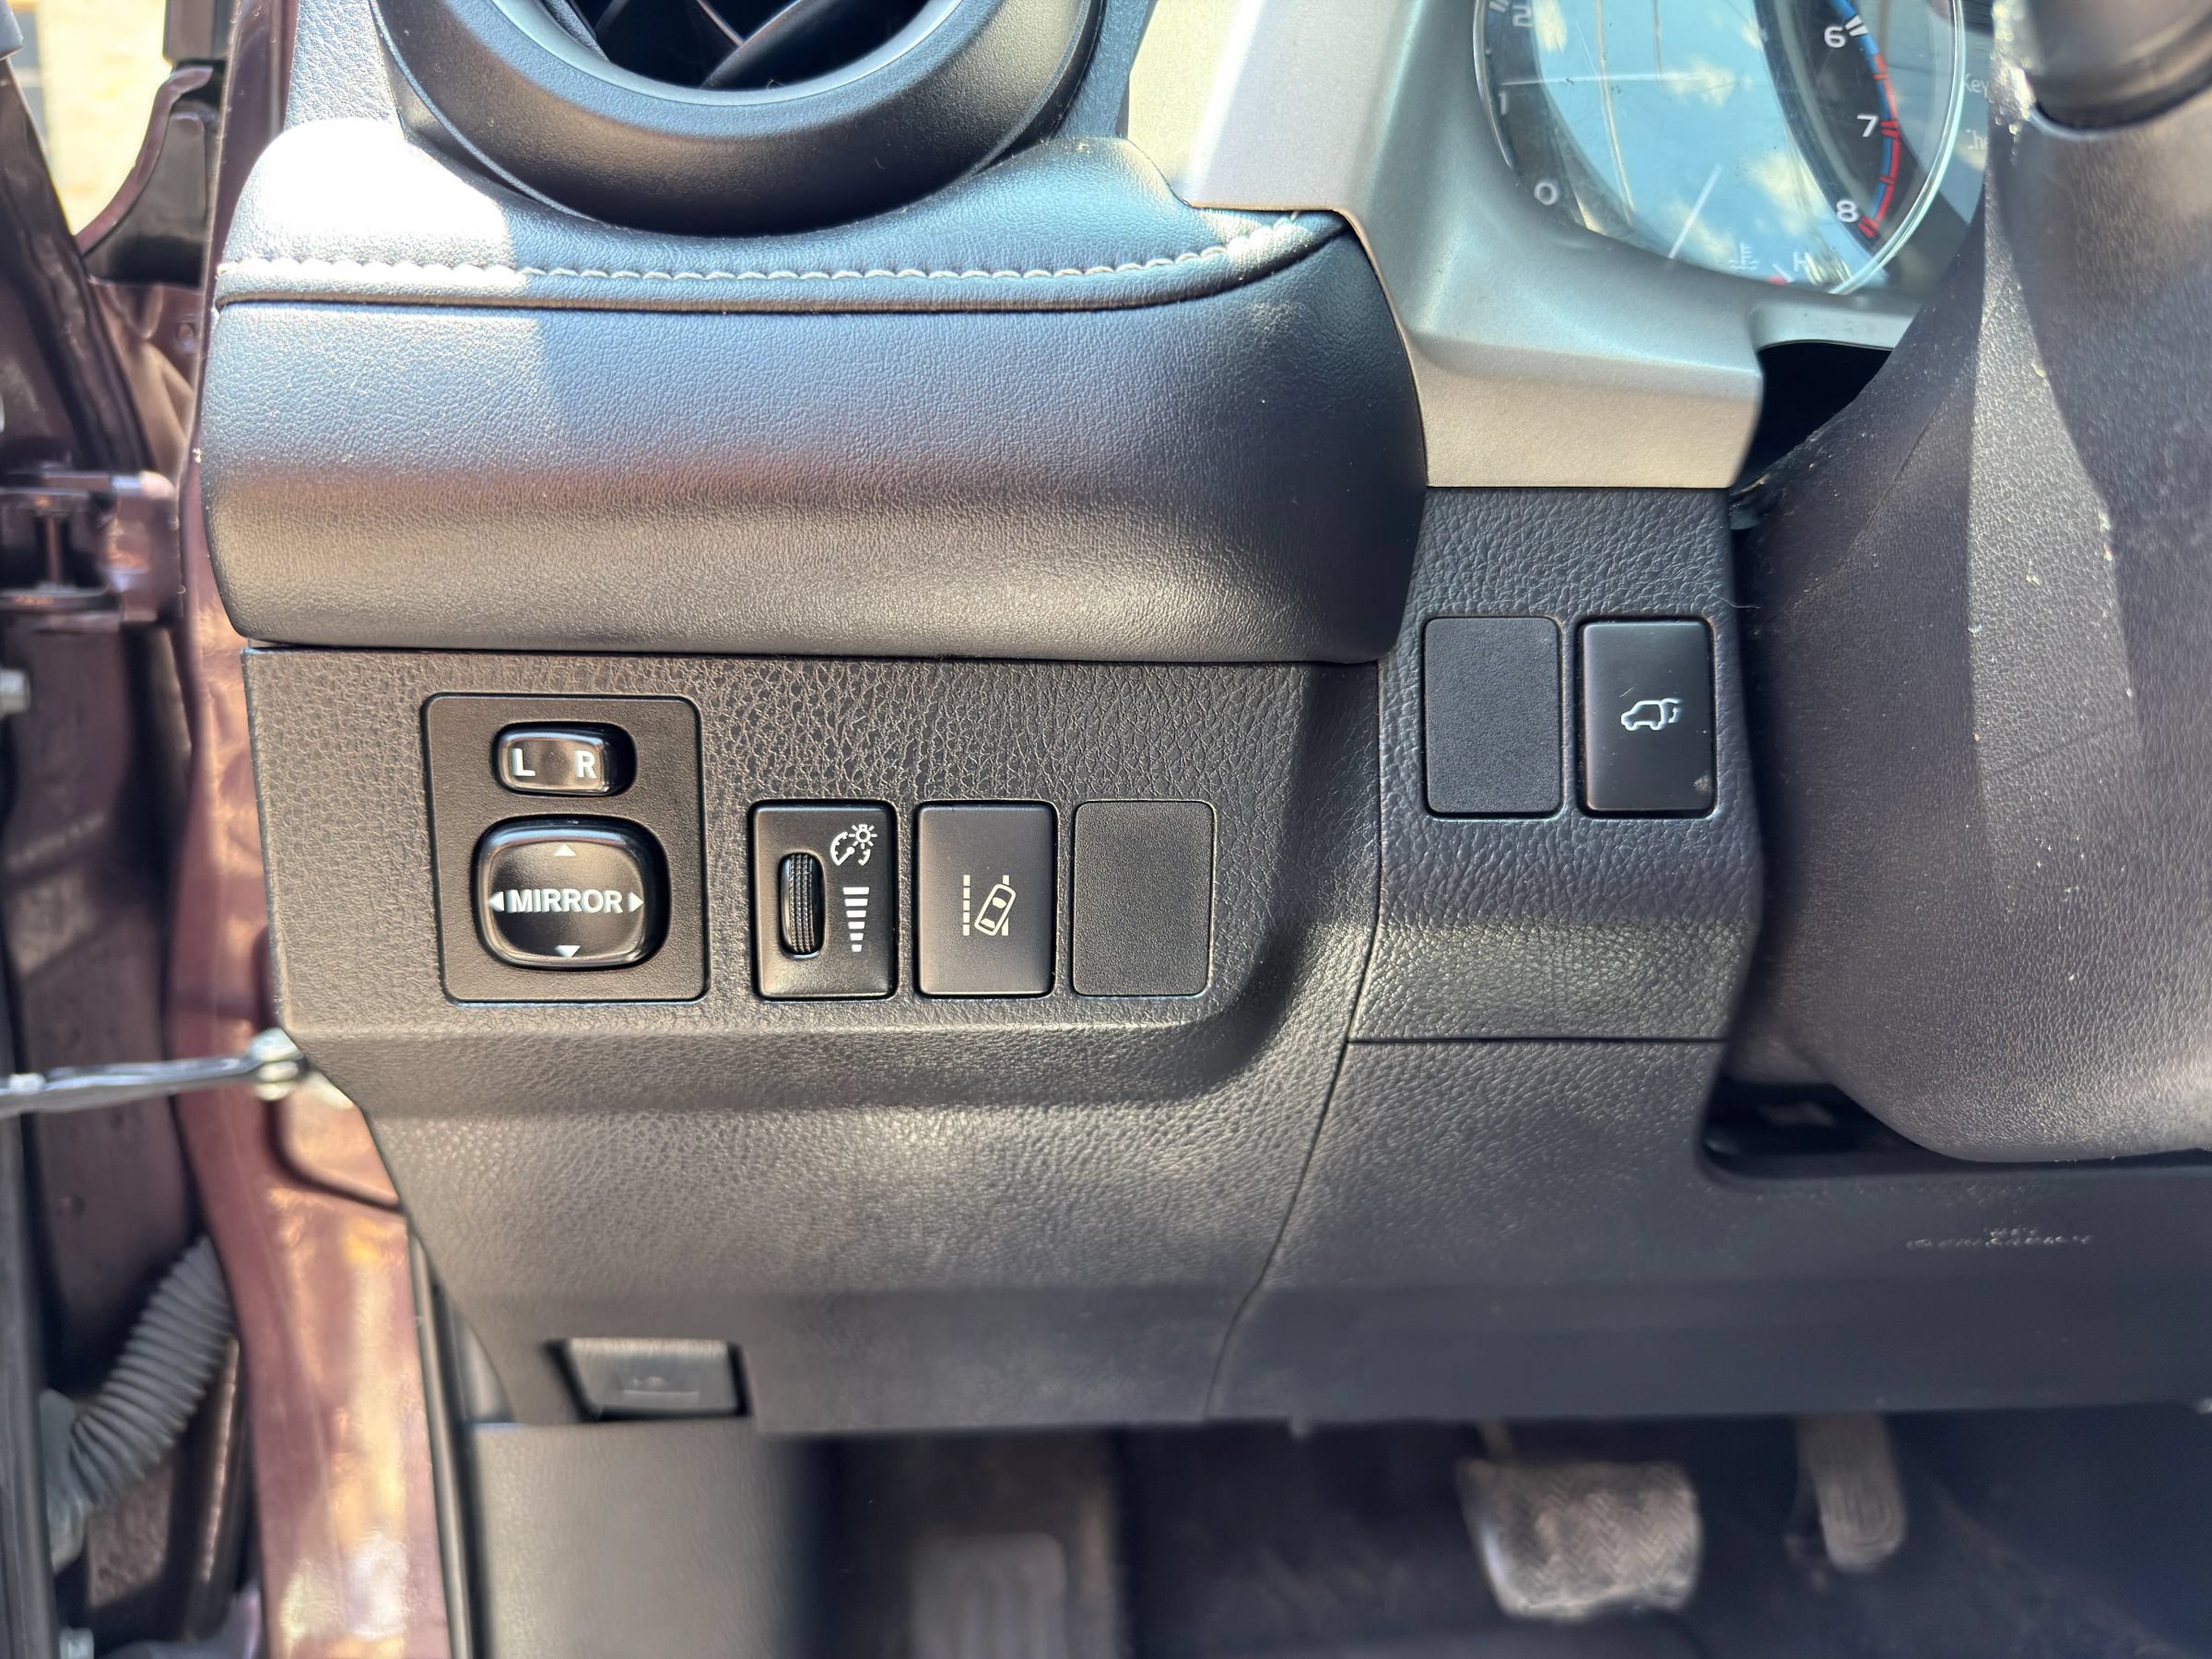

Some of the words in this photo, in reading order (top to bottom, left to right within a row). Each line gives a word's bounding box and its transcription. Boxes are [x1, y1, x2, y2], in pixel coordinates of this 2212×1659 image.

[1824, 25, 1846, 48] 6
[1856, 115, 1879, 137] 7
[1836, 200, 1859, 223] 8
[510, 747, 535, 777] L
[574, 750, 596, 779] R
[508, 888, 623, 914] MIRROR
